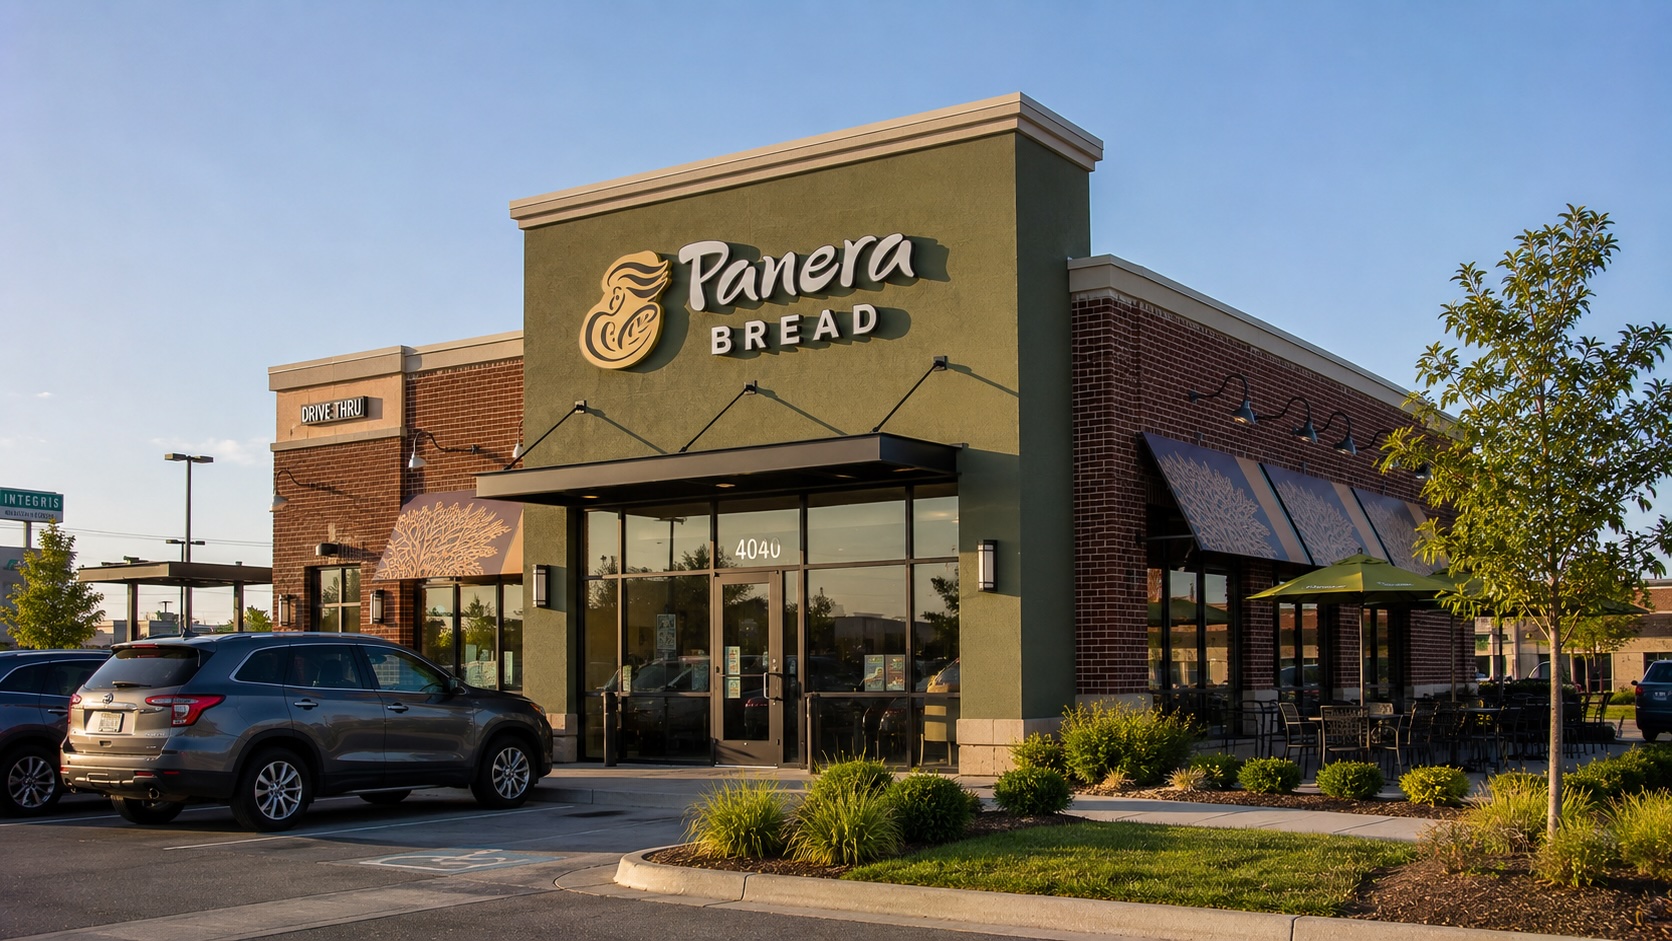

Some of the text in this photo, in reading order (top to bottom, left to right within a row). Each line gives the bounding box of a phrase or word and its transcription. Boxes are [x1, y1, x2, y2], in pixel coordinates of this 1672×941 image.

[678, 232, 915, 311] Panera
[711, 303, 878, 355] BREAD
[301, 398, 362, 423] DRIVE THRU
[4, 493, 59, 508] INTEGRIS
[735, 537, 781, 560] 4040
